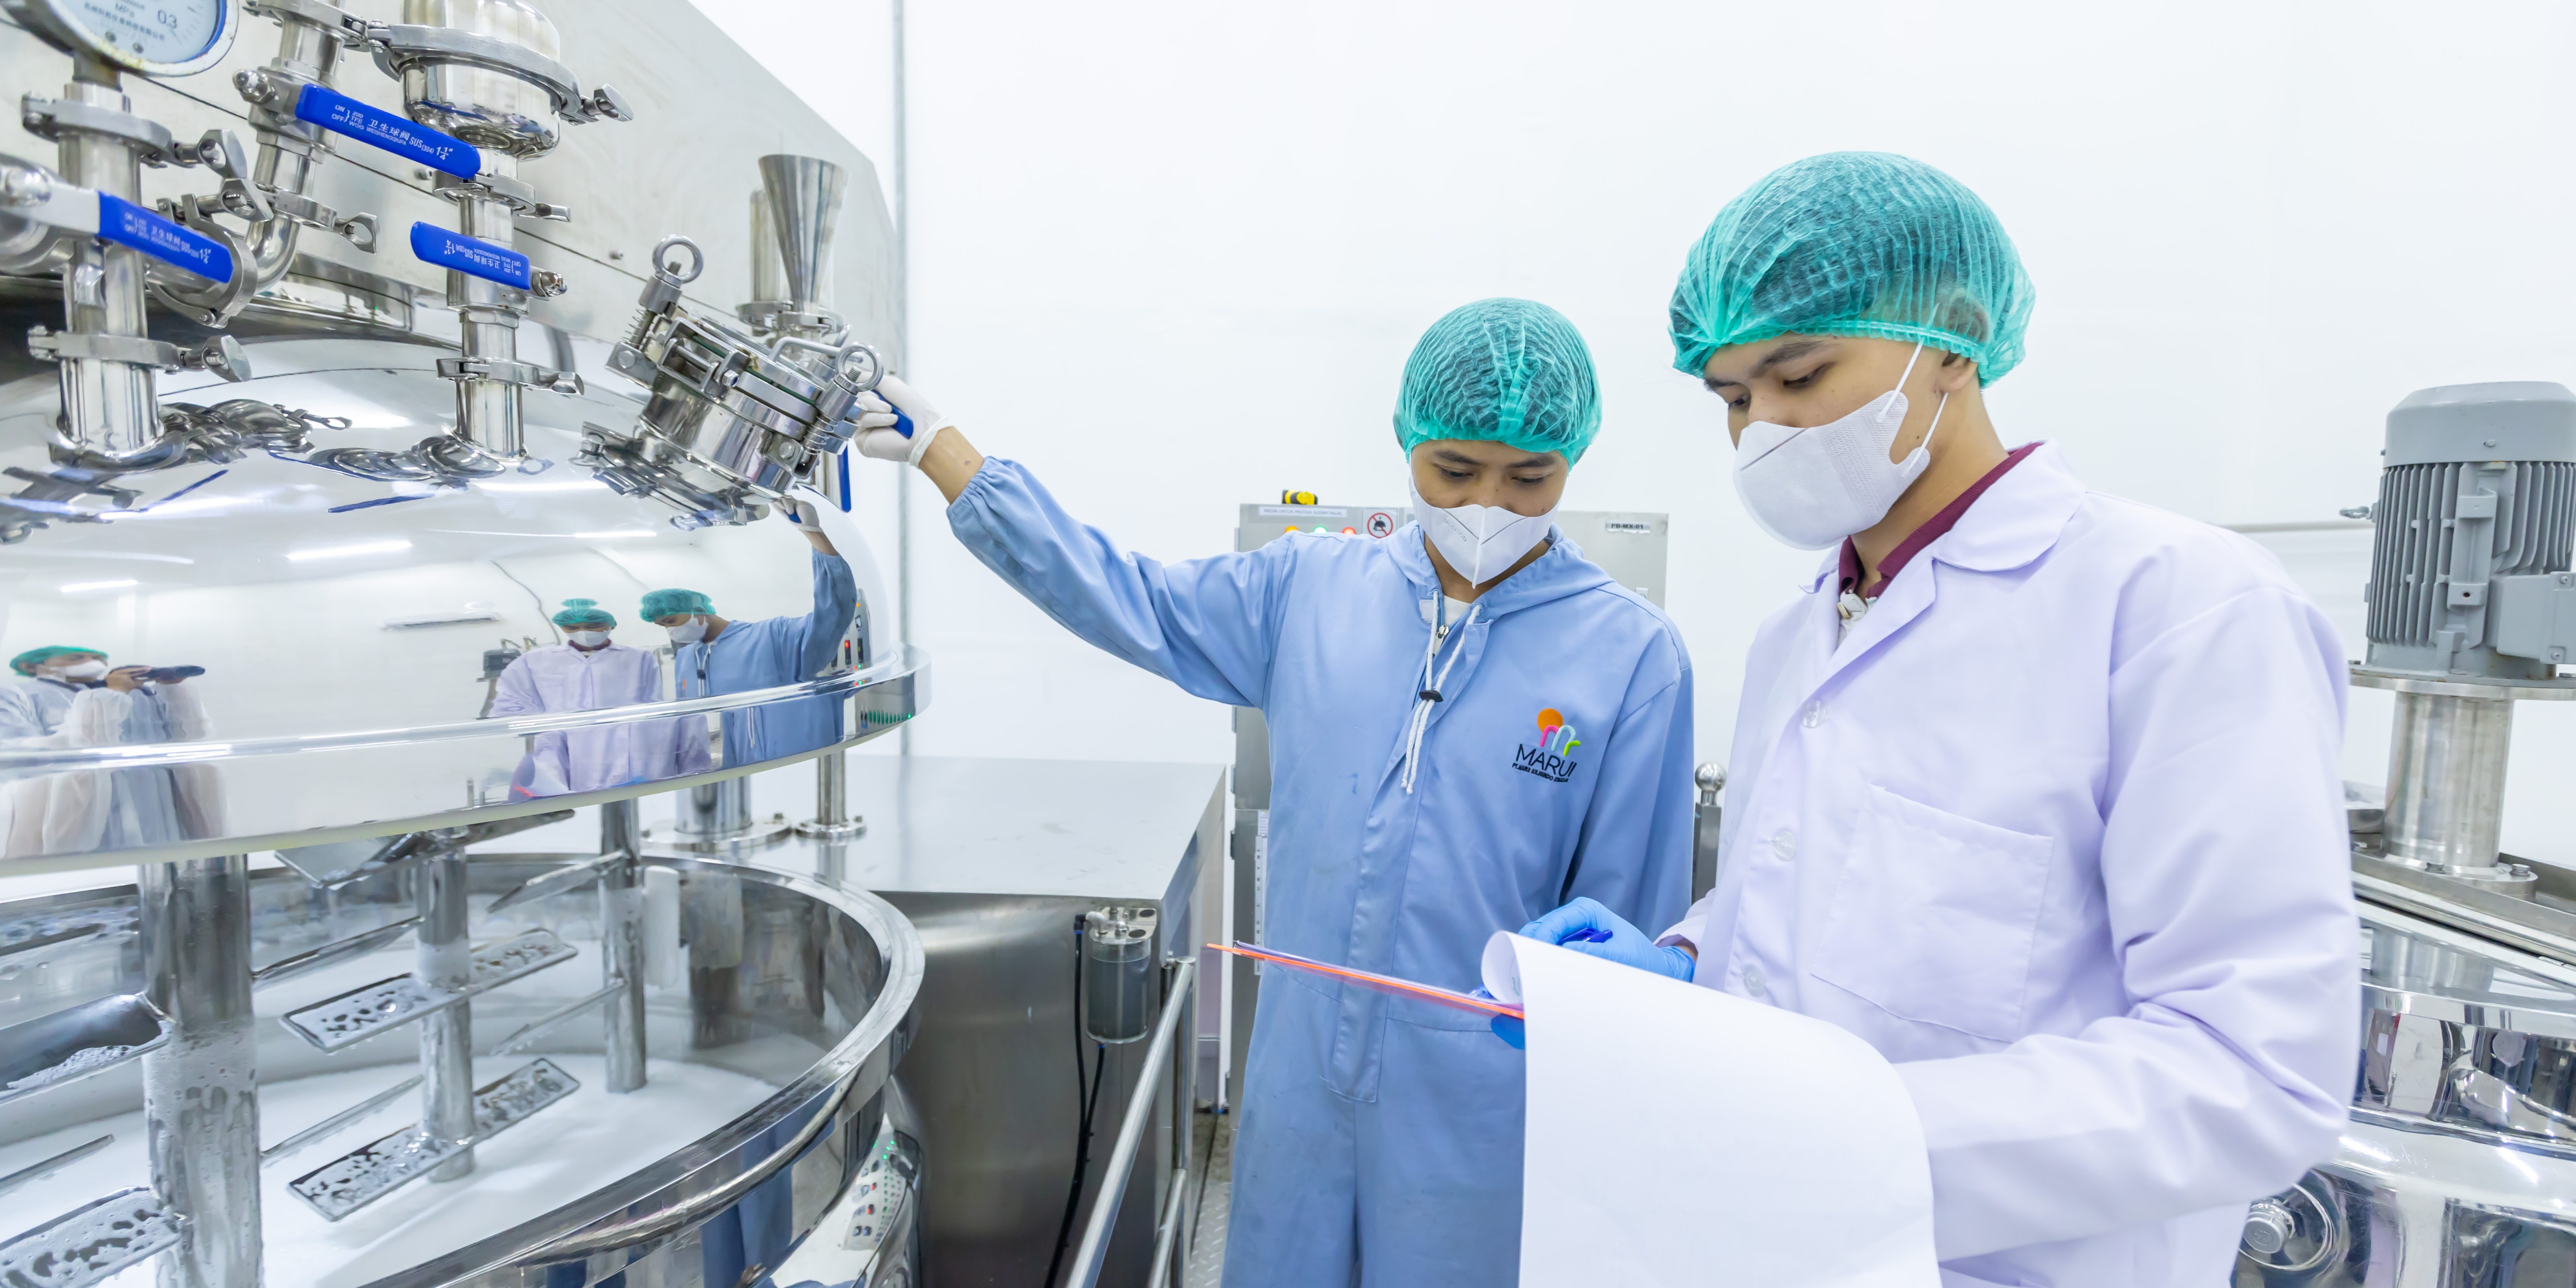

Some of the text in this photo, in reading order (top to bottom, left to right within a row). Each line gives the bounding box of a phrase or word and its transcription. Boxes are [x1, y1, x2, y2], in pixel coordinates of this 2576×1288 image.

[349, 121, 364, 130] WOG
[351, 115, 363, 124] TFE
[366, 127, 406, 146] WEISHENGQIUFA
[367, 119, 410, 141] 卫生球阀
[1516, 744, 1577, 777] MARUI
